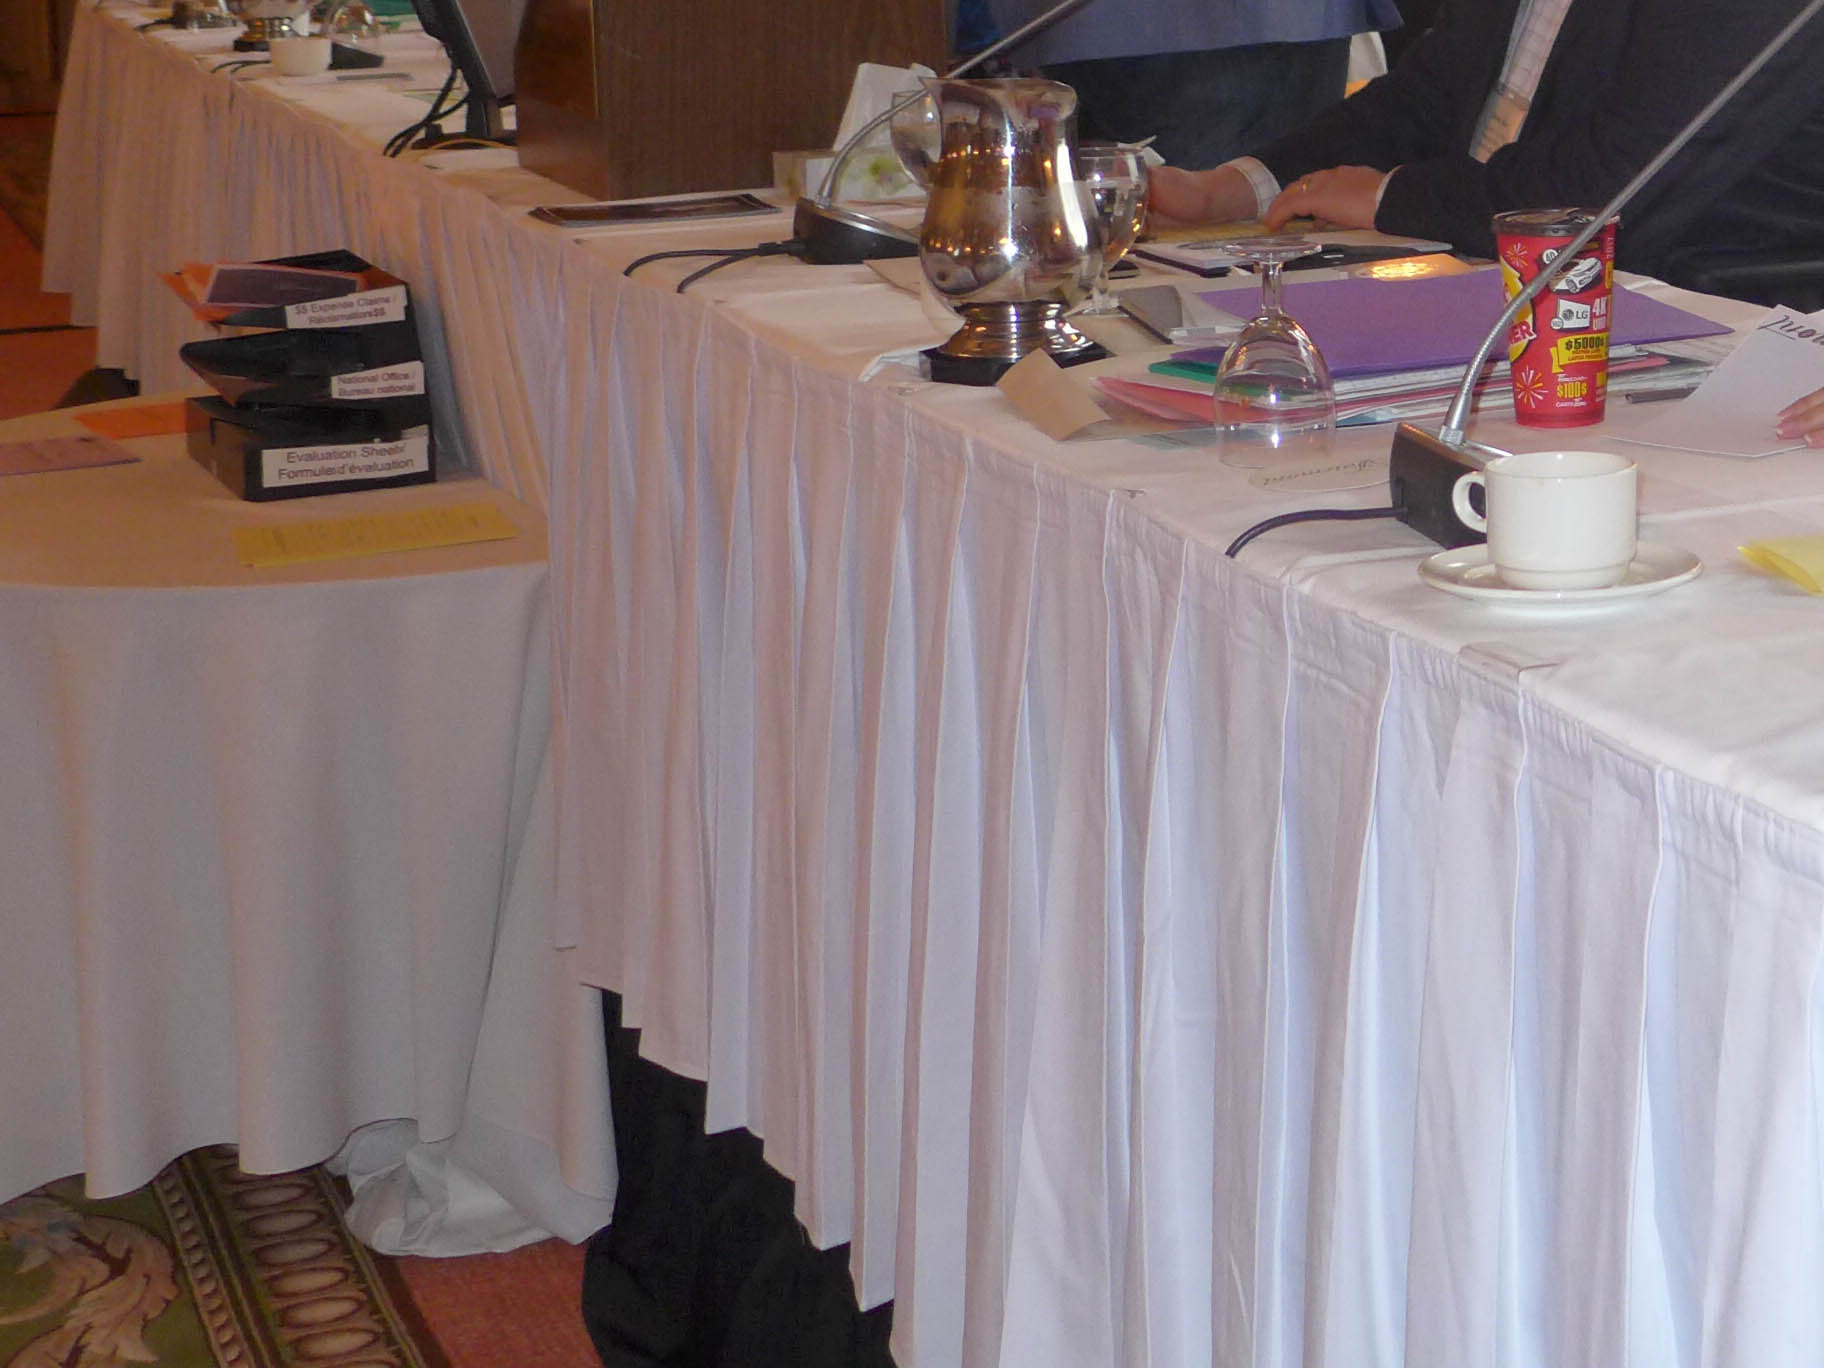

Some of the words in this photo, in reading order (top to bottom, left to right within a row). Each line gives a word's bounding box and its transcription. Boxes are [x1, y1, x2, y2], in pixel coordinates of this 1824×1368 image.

[1575, 310, 1588, 320] LG
[337, 374, 378, 386] National
[381, 371, 409, 382] Office
[286, 447, 357, 464] Evaluation
